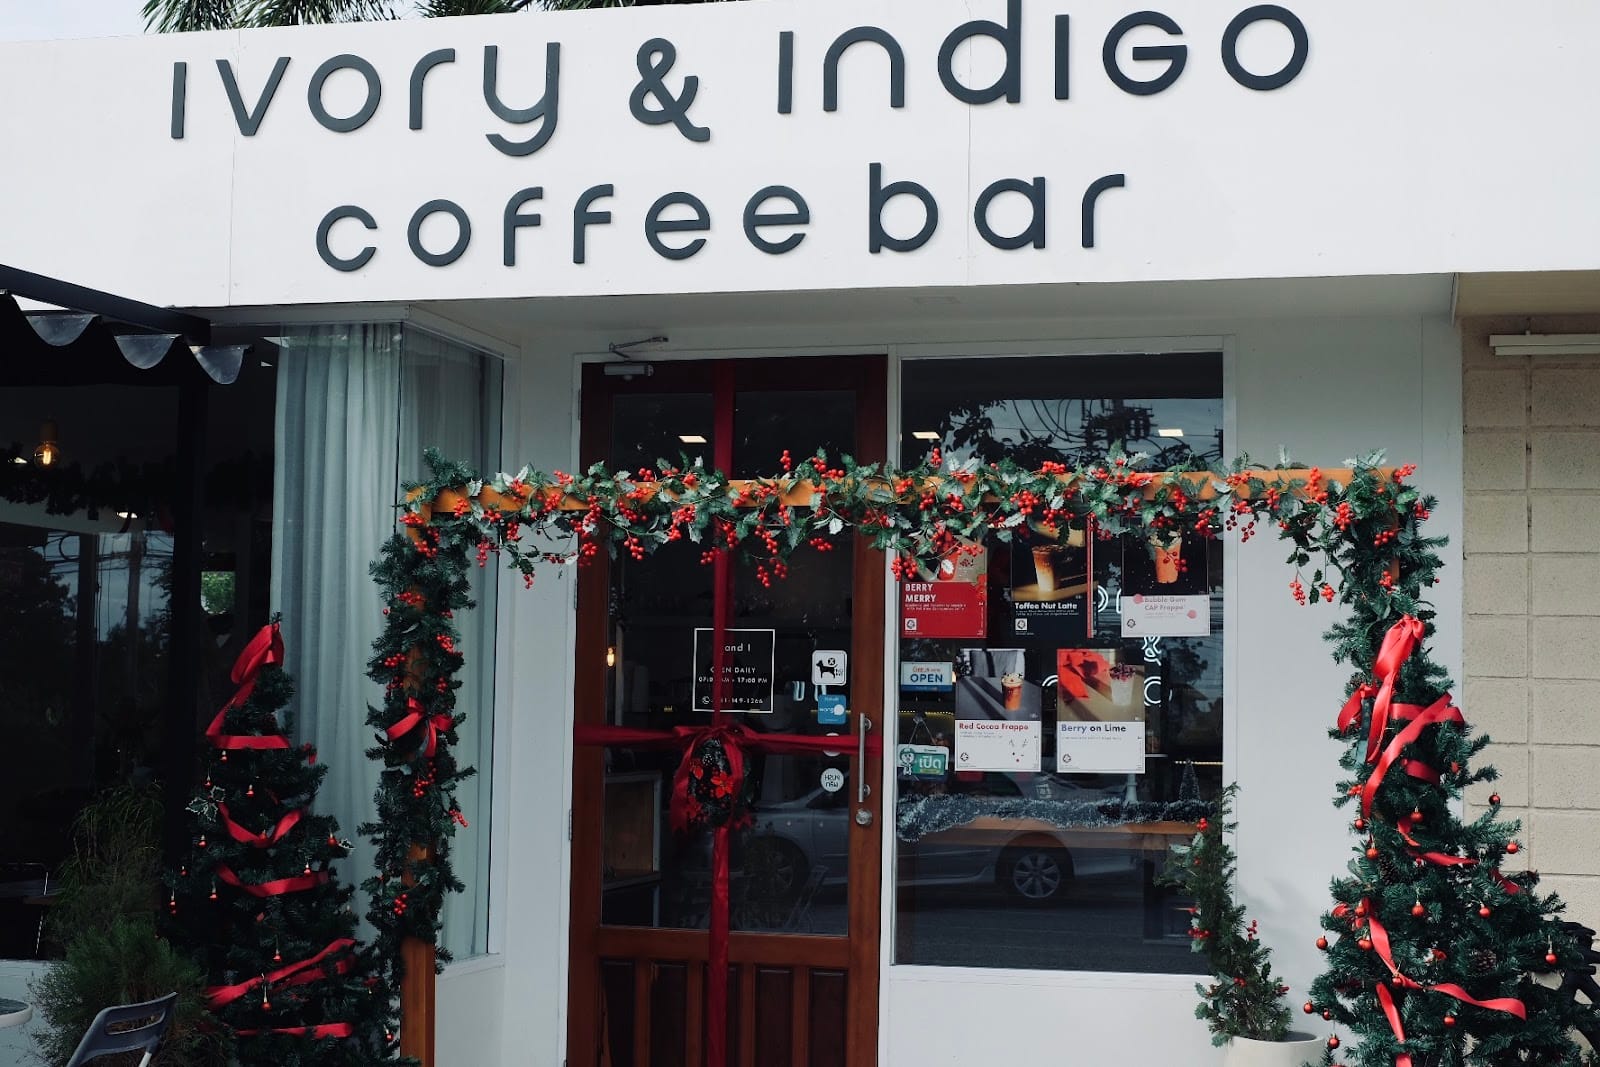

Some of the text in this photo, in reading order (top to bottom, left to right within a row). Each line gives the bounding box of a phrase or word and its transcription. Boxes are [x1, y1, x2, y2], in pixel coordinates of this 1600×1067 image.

[629, 38, 710, 142] &
[316, 163, 1125, 272] coffee bar
[905, 583, 934, 592] BERRY
[905, 594, 937, 603] MERRY
[1015, 602, 1078, 610] Toffee Nut Latte
[724, 642, 744, 652] and
[734, 666, 756, 674] DAILY
[910, 673, 943, 682] OPEN
[1061, 724, 1087, 734] Berry
[1104, 724, 1127, 732] Lime
